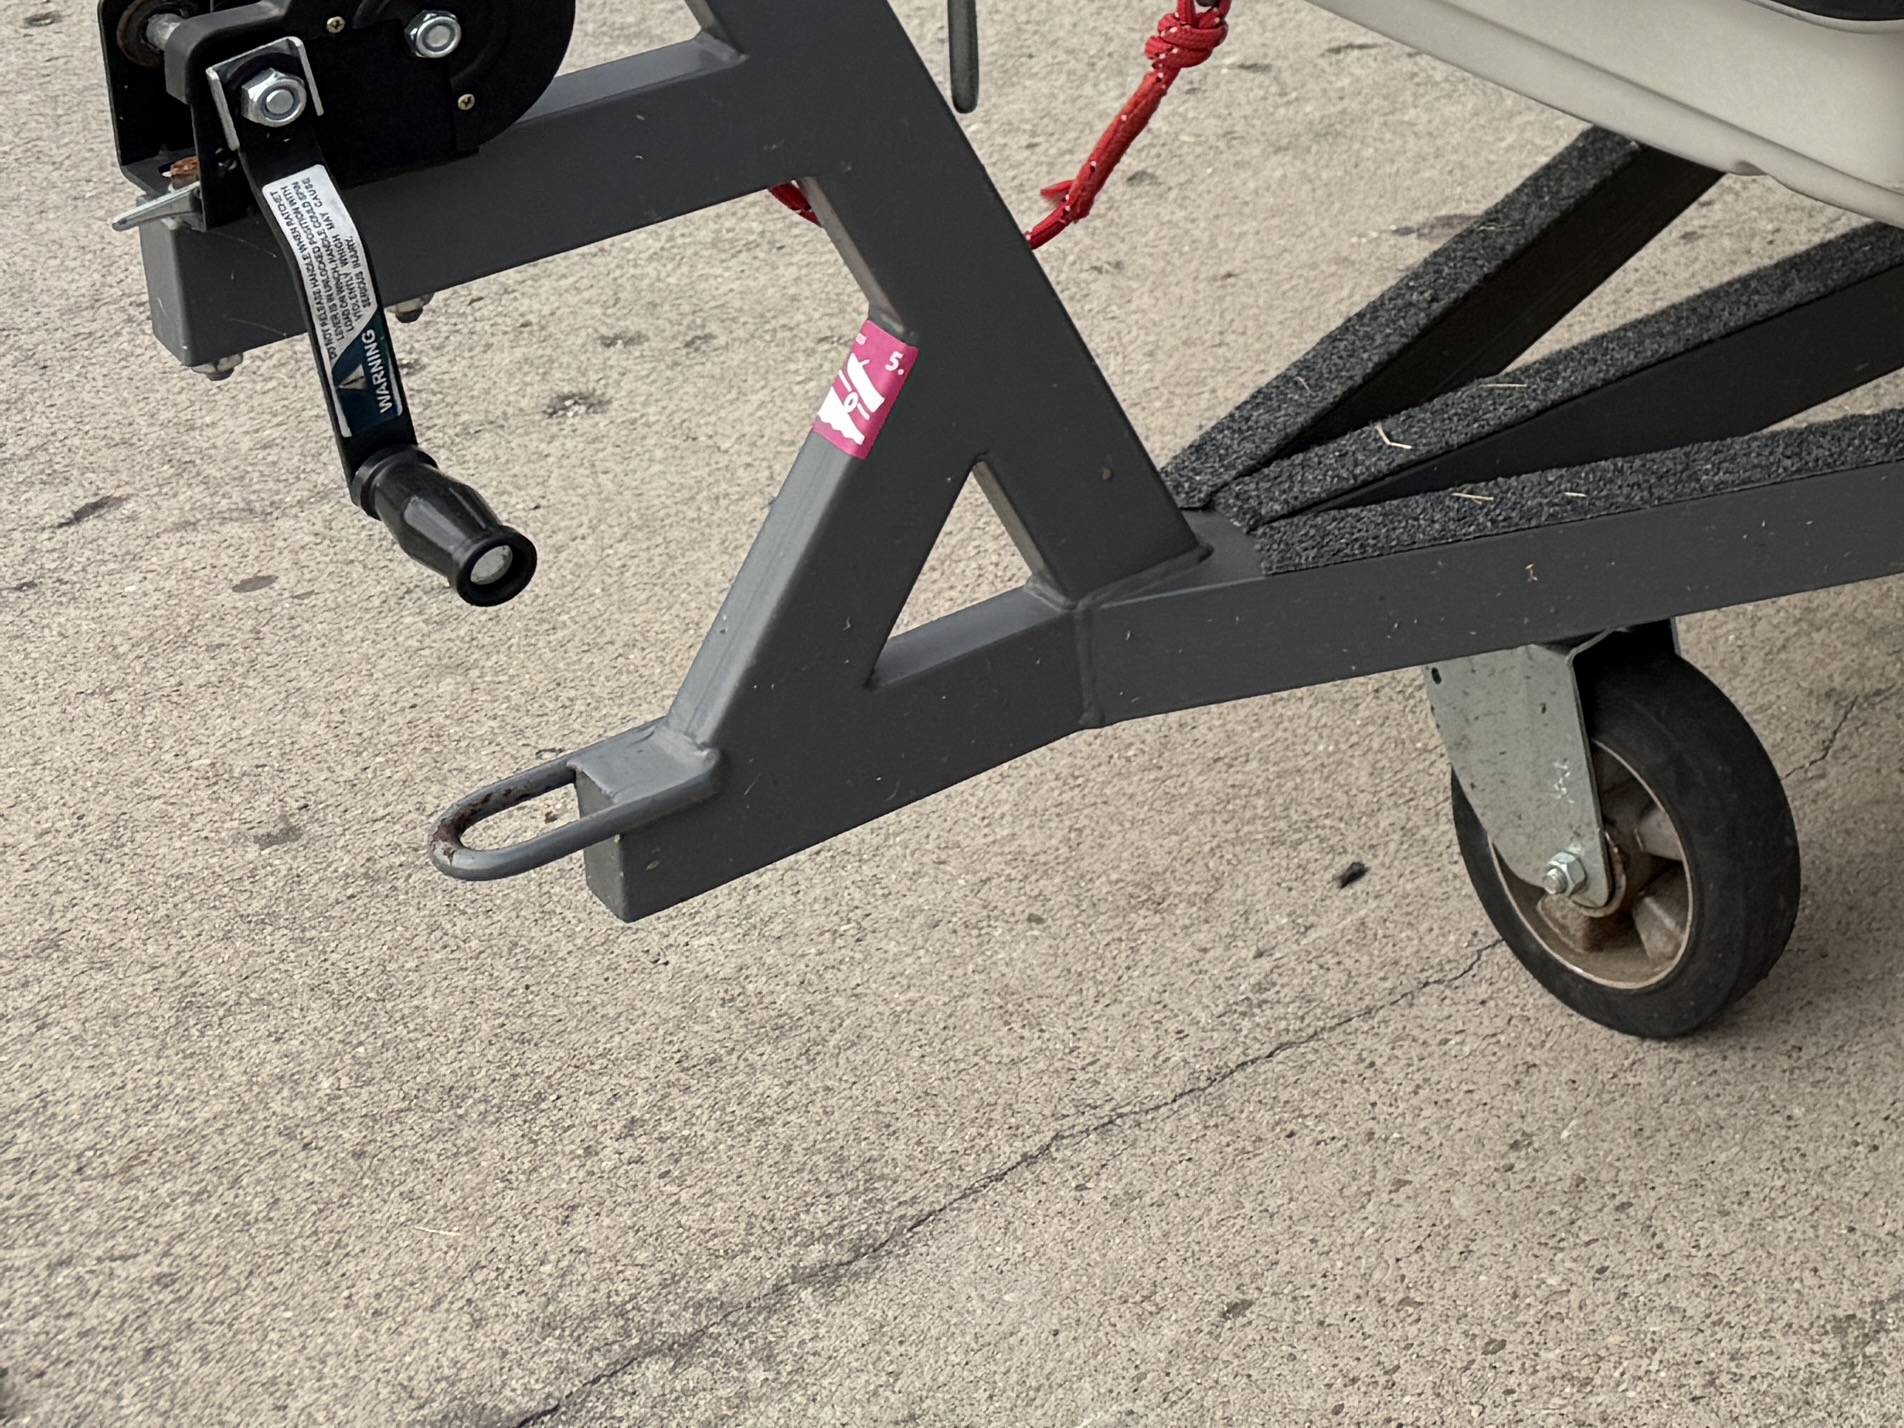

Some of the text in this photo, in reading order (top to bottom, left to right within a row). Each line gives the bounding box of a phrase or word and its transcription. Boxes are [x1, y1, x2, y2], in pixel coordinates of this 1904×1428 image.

[280, 186, 296, 207] WITH
[292, 207, 317, 246] POSITION
[303, 202, 321, 229] COULD
[290, 227, 307, 254] WHEN
[302, 177, 362, 322] VIOLENTLY WHICH MAY CAUSE
[317, 229, 336, 264] HANDLE
[302, 253, 319, 289] HANDLE
[312, 246, 332, 293] UNLOCKED
[331, 313, 344, 341] LEVER
[342, 309, 354, 333] LOAD
[362, 329, 392, 413] WARNING
[885, 351, 904, 375] 5.
